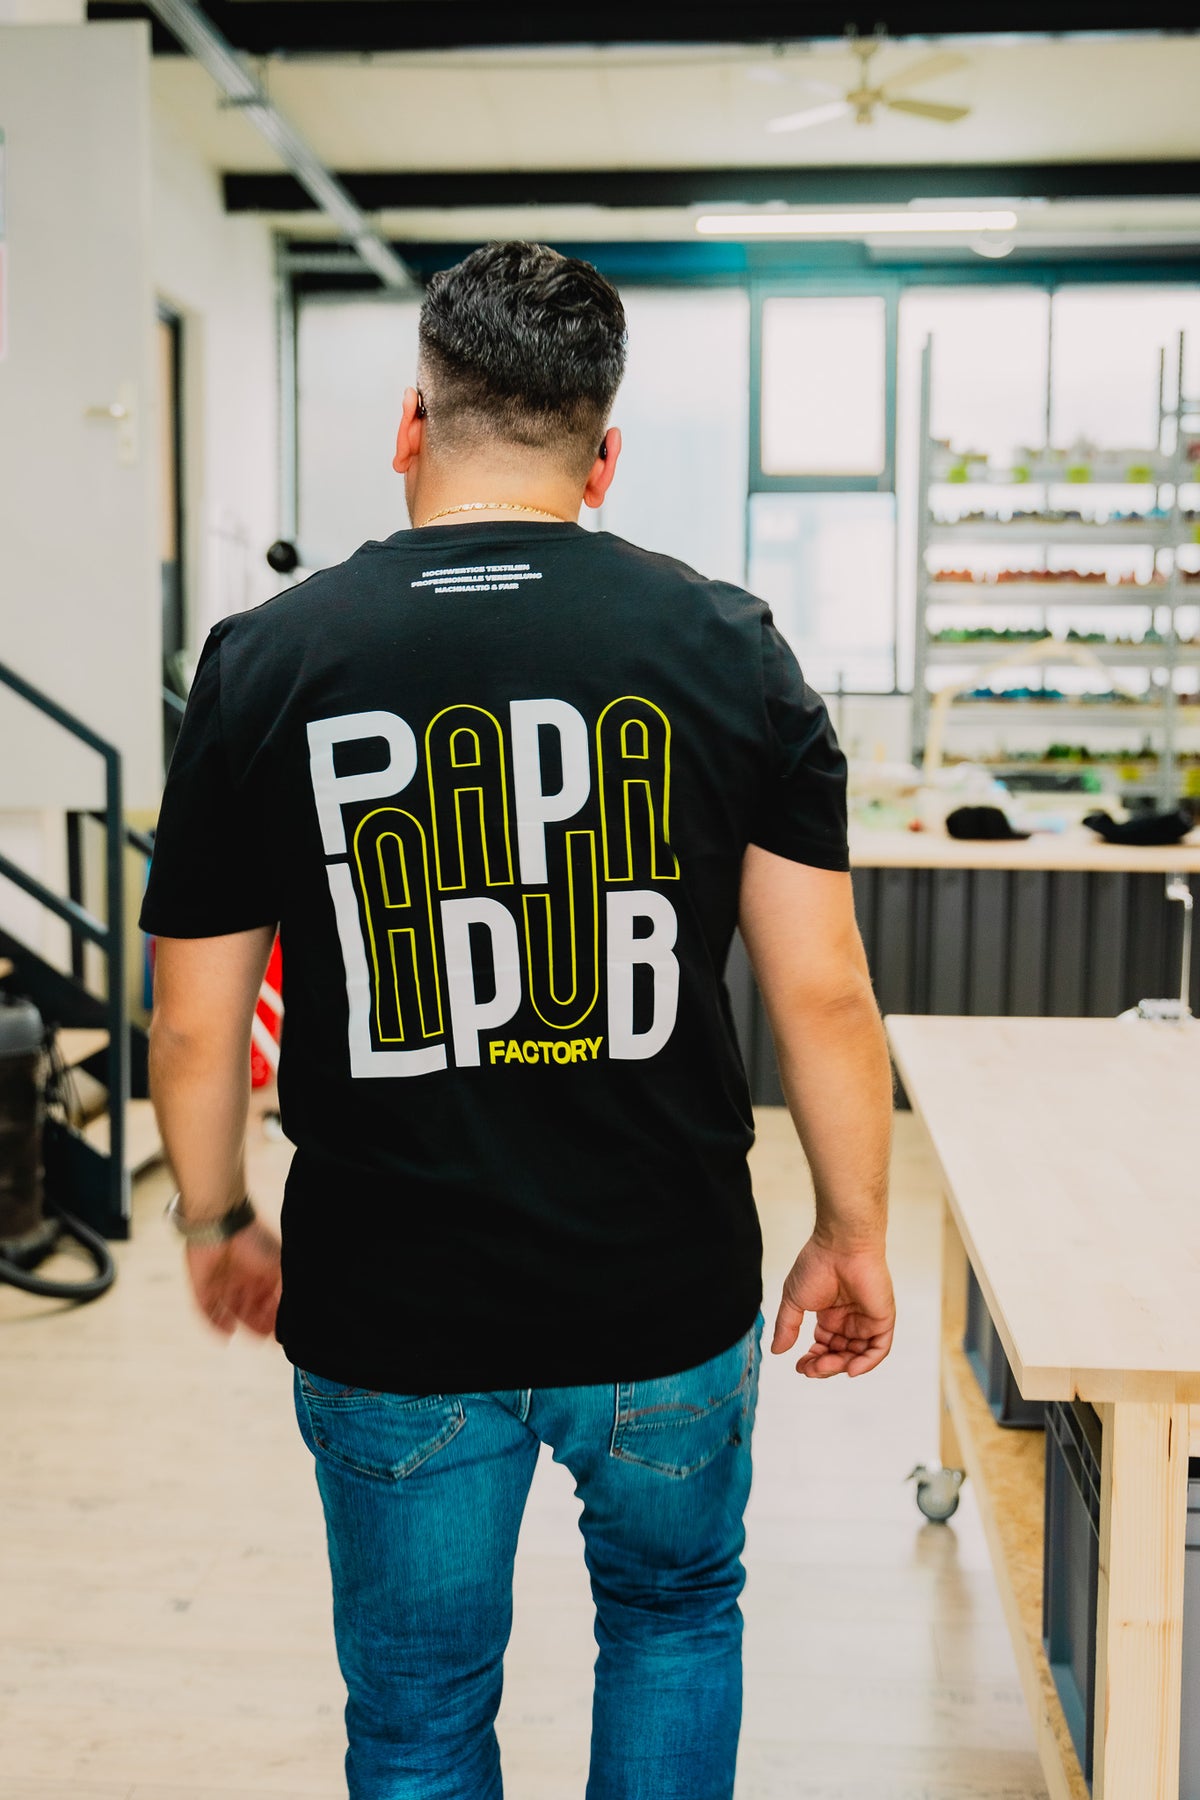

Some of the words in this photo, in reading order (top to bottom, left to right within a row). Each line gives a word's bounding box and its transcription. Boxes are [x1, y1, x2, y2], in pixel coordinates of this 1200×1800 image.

[435, 584, 490, 593] NACHHALTIG
[306, 695, 680, 890] PAPA
[489, 1036, 603, 1064] FACTORY
